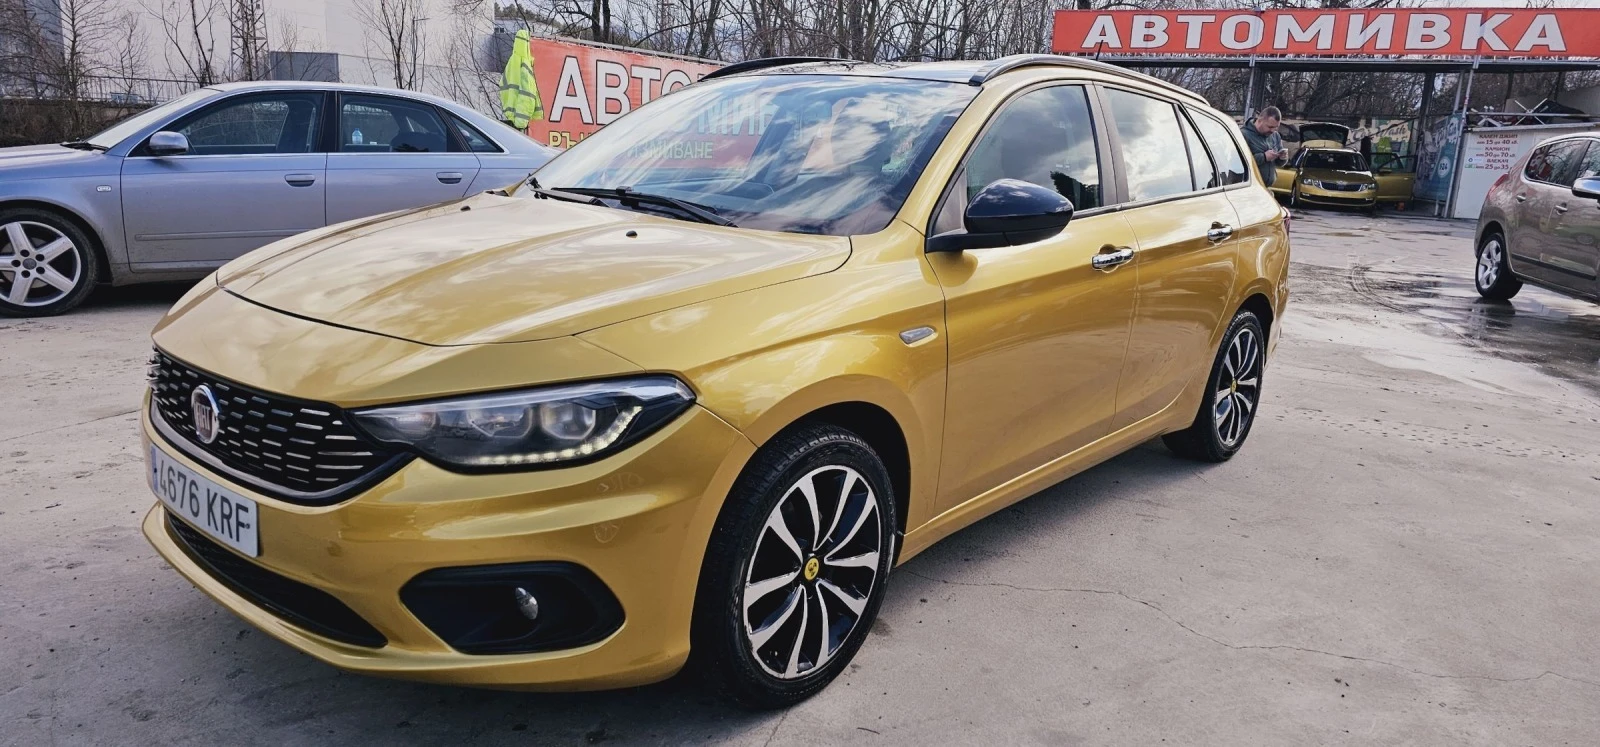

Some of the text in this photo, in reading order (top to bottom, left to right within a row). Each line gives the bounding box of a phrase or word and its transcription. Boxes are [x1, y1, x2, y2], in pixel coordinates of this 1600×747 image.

[1081, 13, 1567, 52] АВТОМИВКА
[160, 460, 249, 542] 4676 KRF
